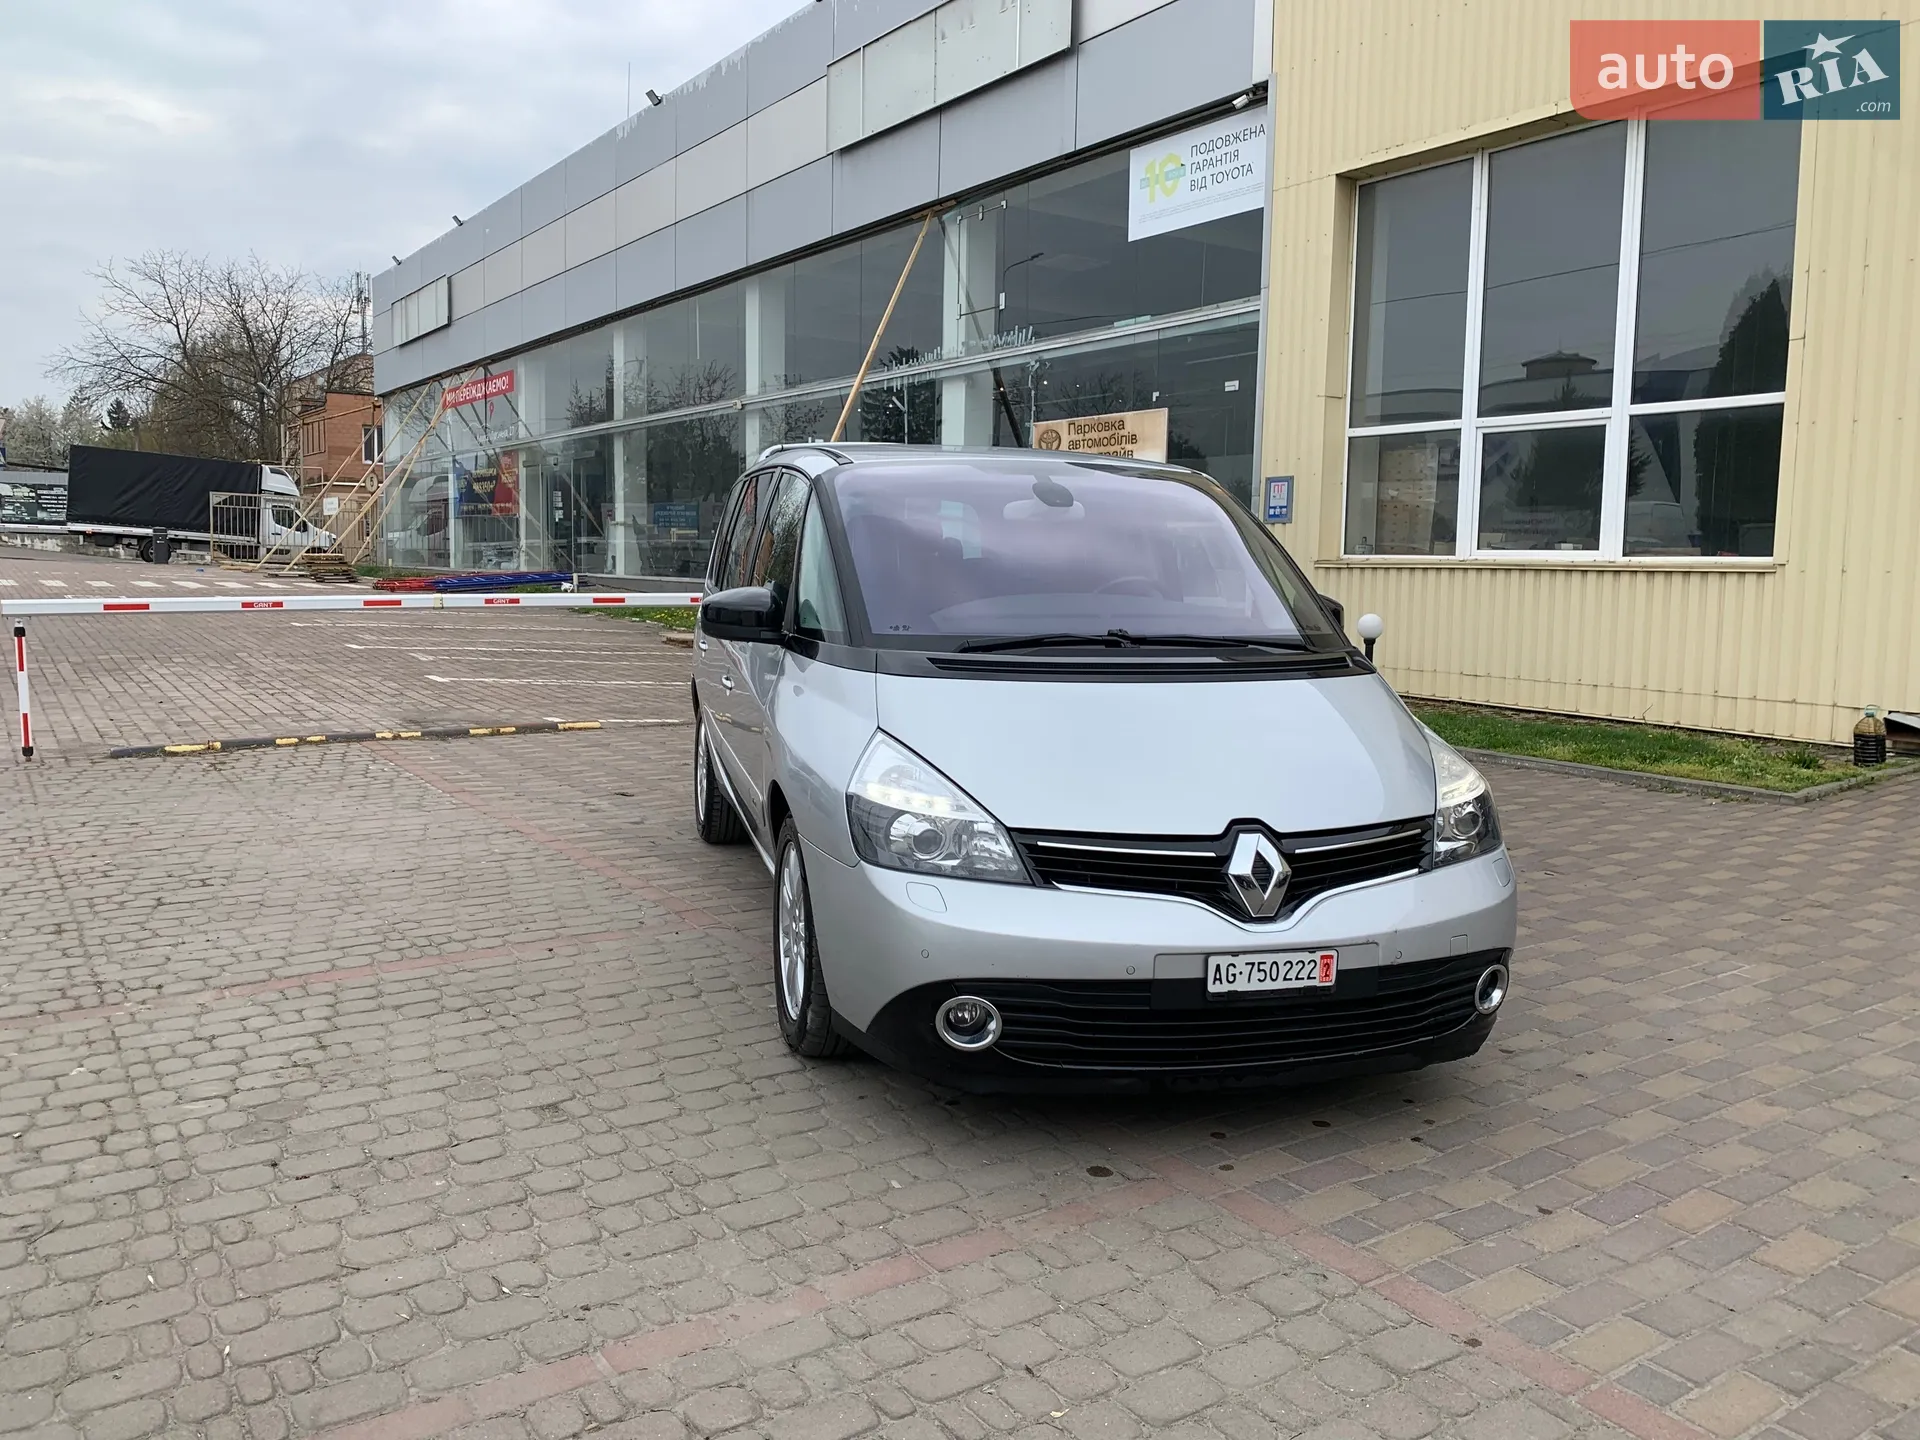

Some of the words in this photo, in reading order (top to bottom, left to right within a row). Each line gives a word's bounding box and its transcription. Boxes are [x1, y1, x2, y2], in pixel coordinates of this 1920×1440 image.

[1190, 124, 1266, 158] ПОДОВЖЕНА
[1190, 149, 1240, 175] ГАРАНТІЯ
[1189, 175, 1207, 192] ВІД
[1068, 419, 1125, 436] Парковка
[1068, 432, 1138, 450] автомобілів
